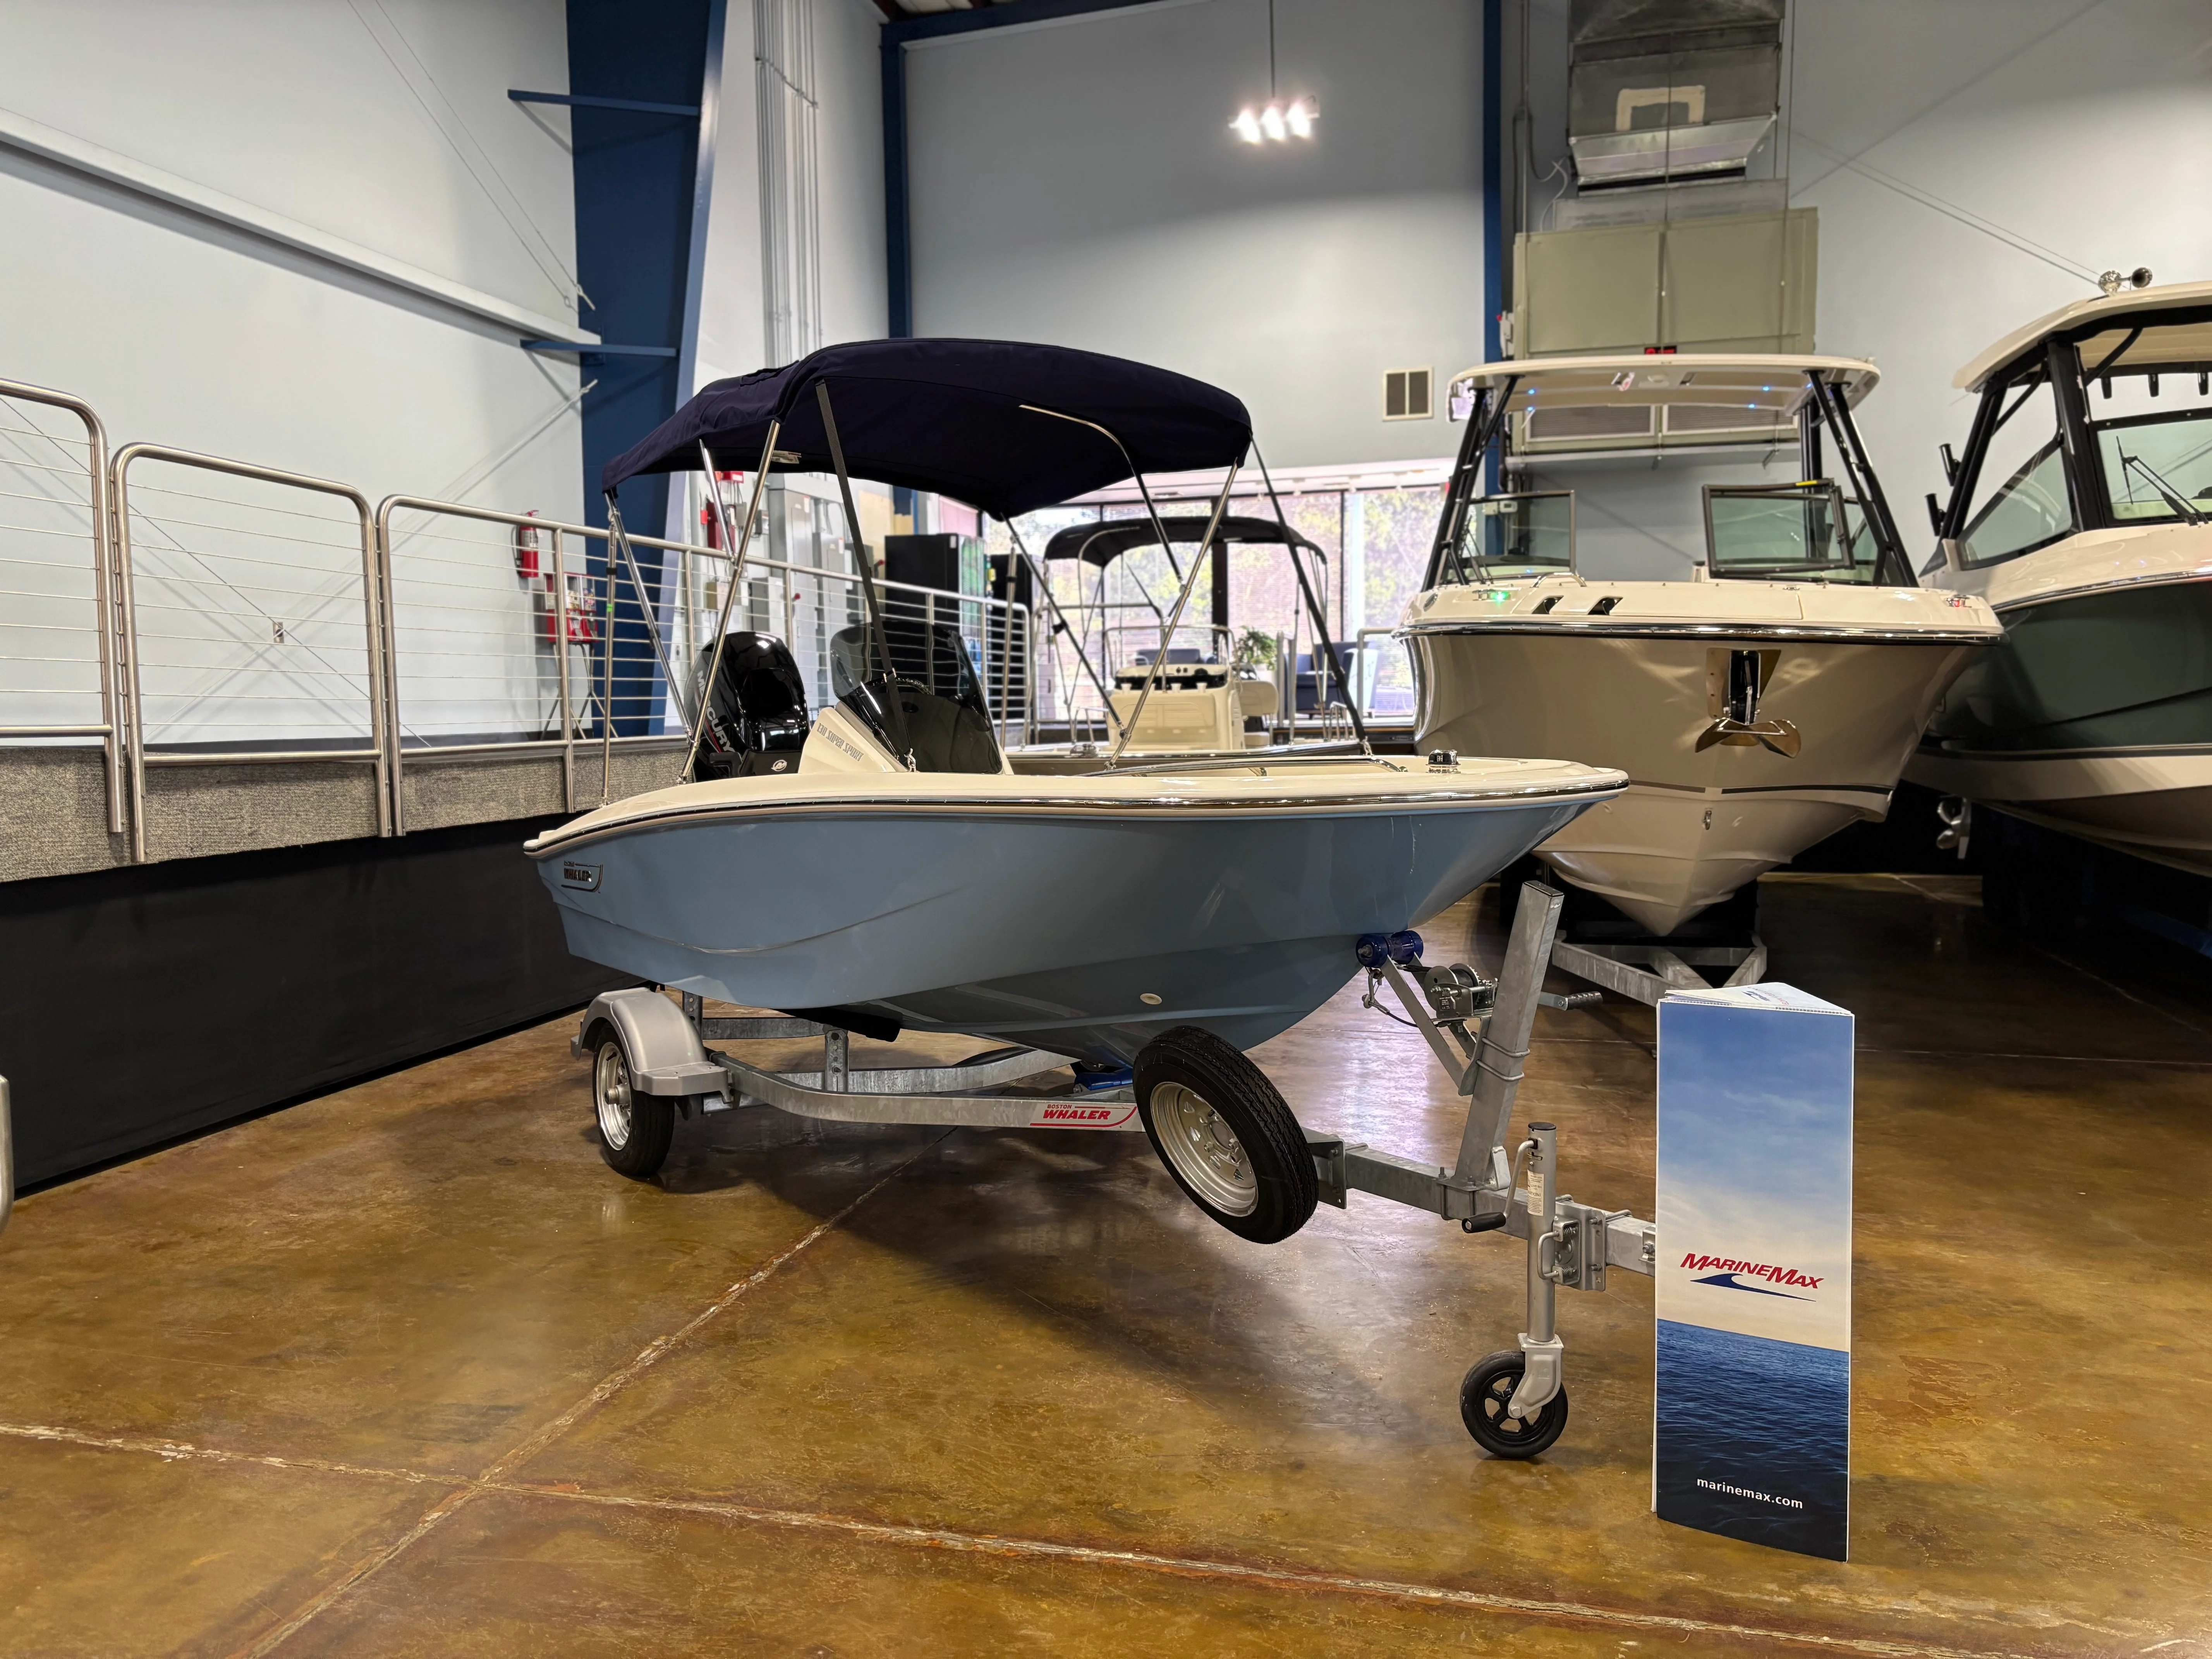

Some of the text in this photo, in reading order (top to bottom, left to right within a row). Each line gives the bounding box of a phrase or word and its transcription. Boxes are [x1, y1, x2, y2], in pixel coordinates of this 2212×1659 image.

[826, 730, 845, 749] SUPER
[843, 742, 864, 761] SPORT
[1043, 1109, 1111, 1120] WHALER
[1697, 1478, 1803, 1509] marinemax.com
